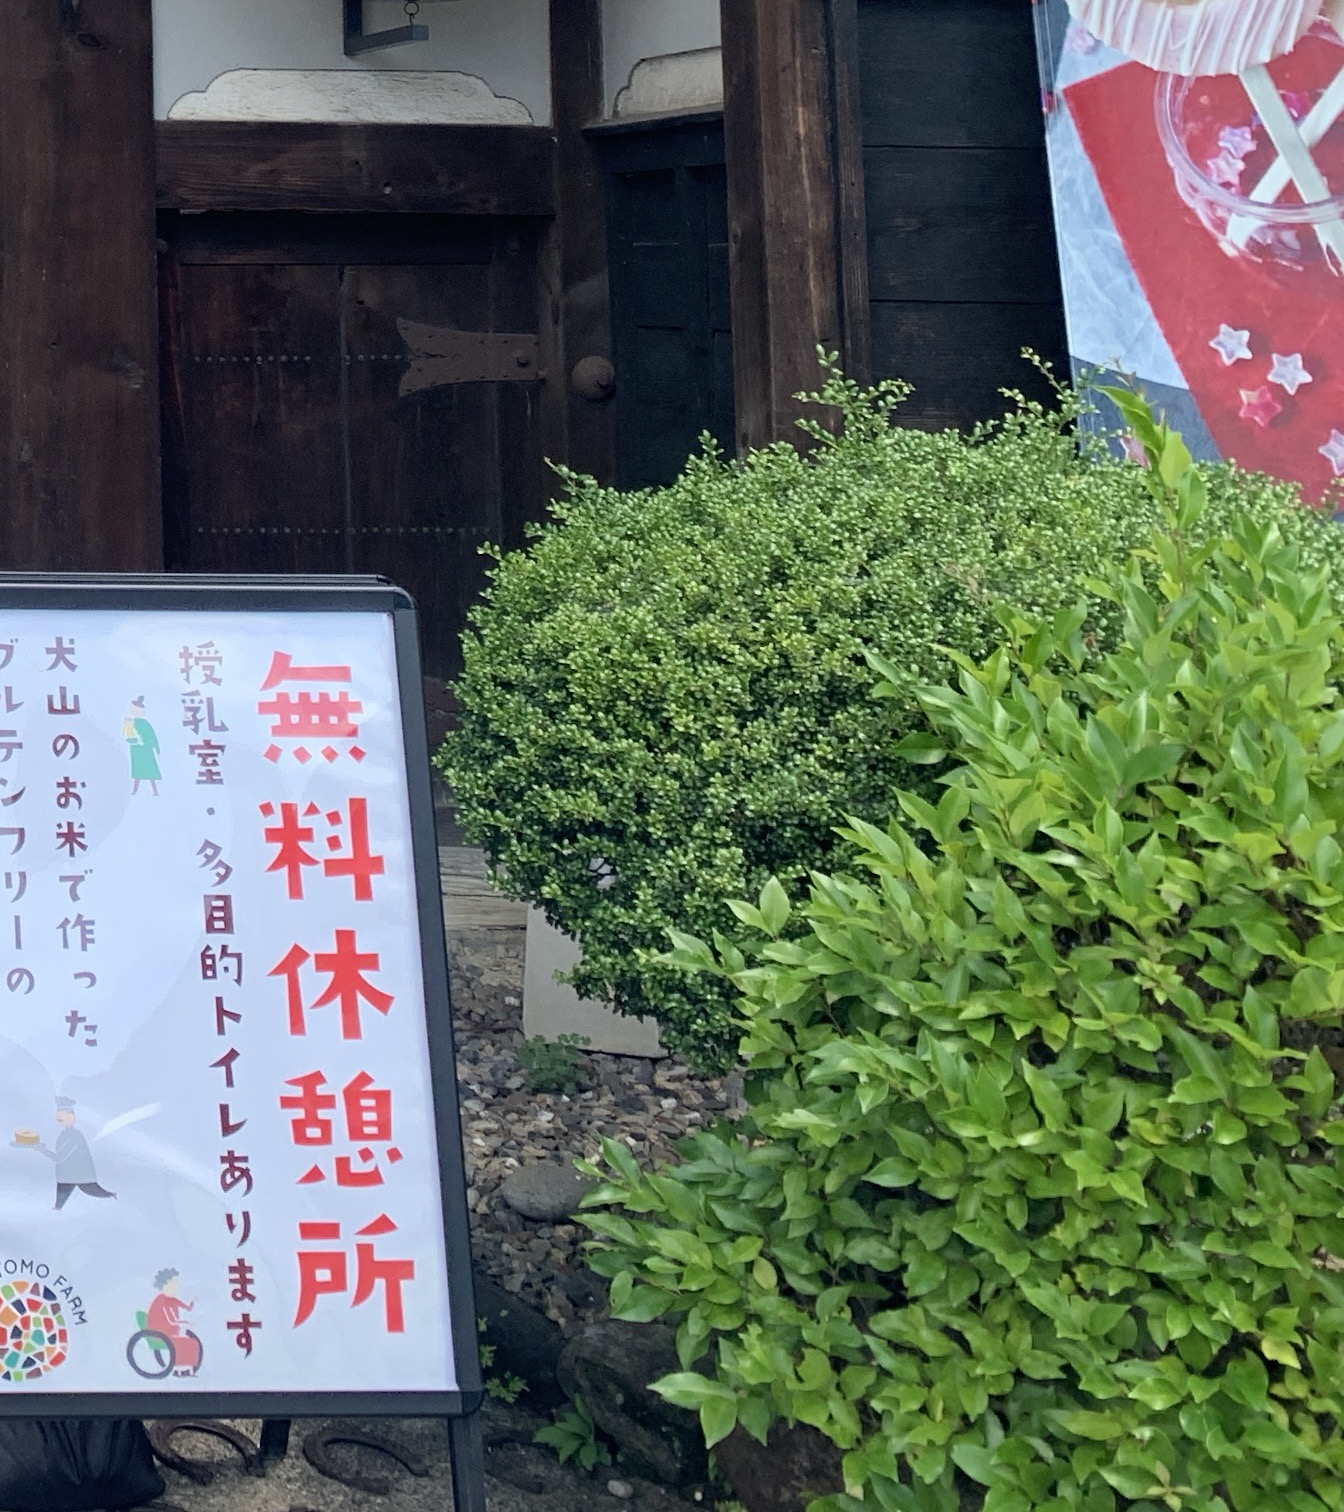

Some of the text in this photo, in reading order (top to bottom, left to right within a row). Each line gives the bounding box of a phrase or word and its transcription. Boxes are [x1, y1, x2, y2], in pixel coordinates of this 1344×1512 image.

[44, 636, 100, 1050] 犬山のお米で作った
[178, 640, 264, 1358] 授乳室・多目的トイレあります
[257, 649, 417, 1335] 無料休憩所
[52, 1270, 89, 1328] FARM
